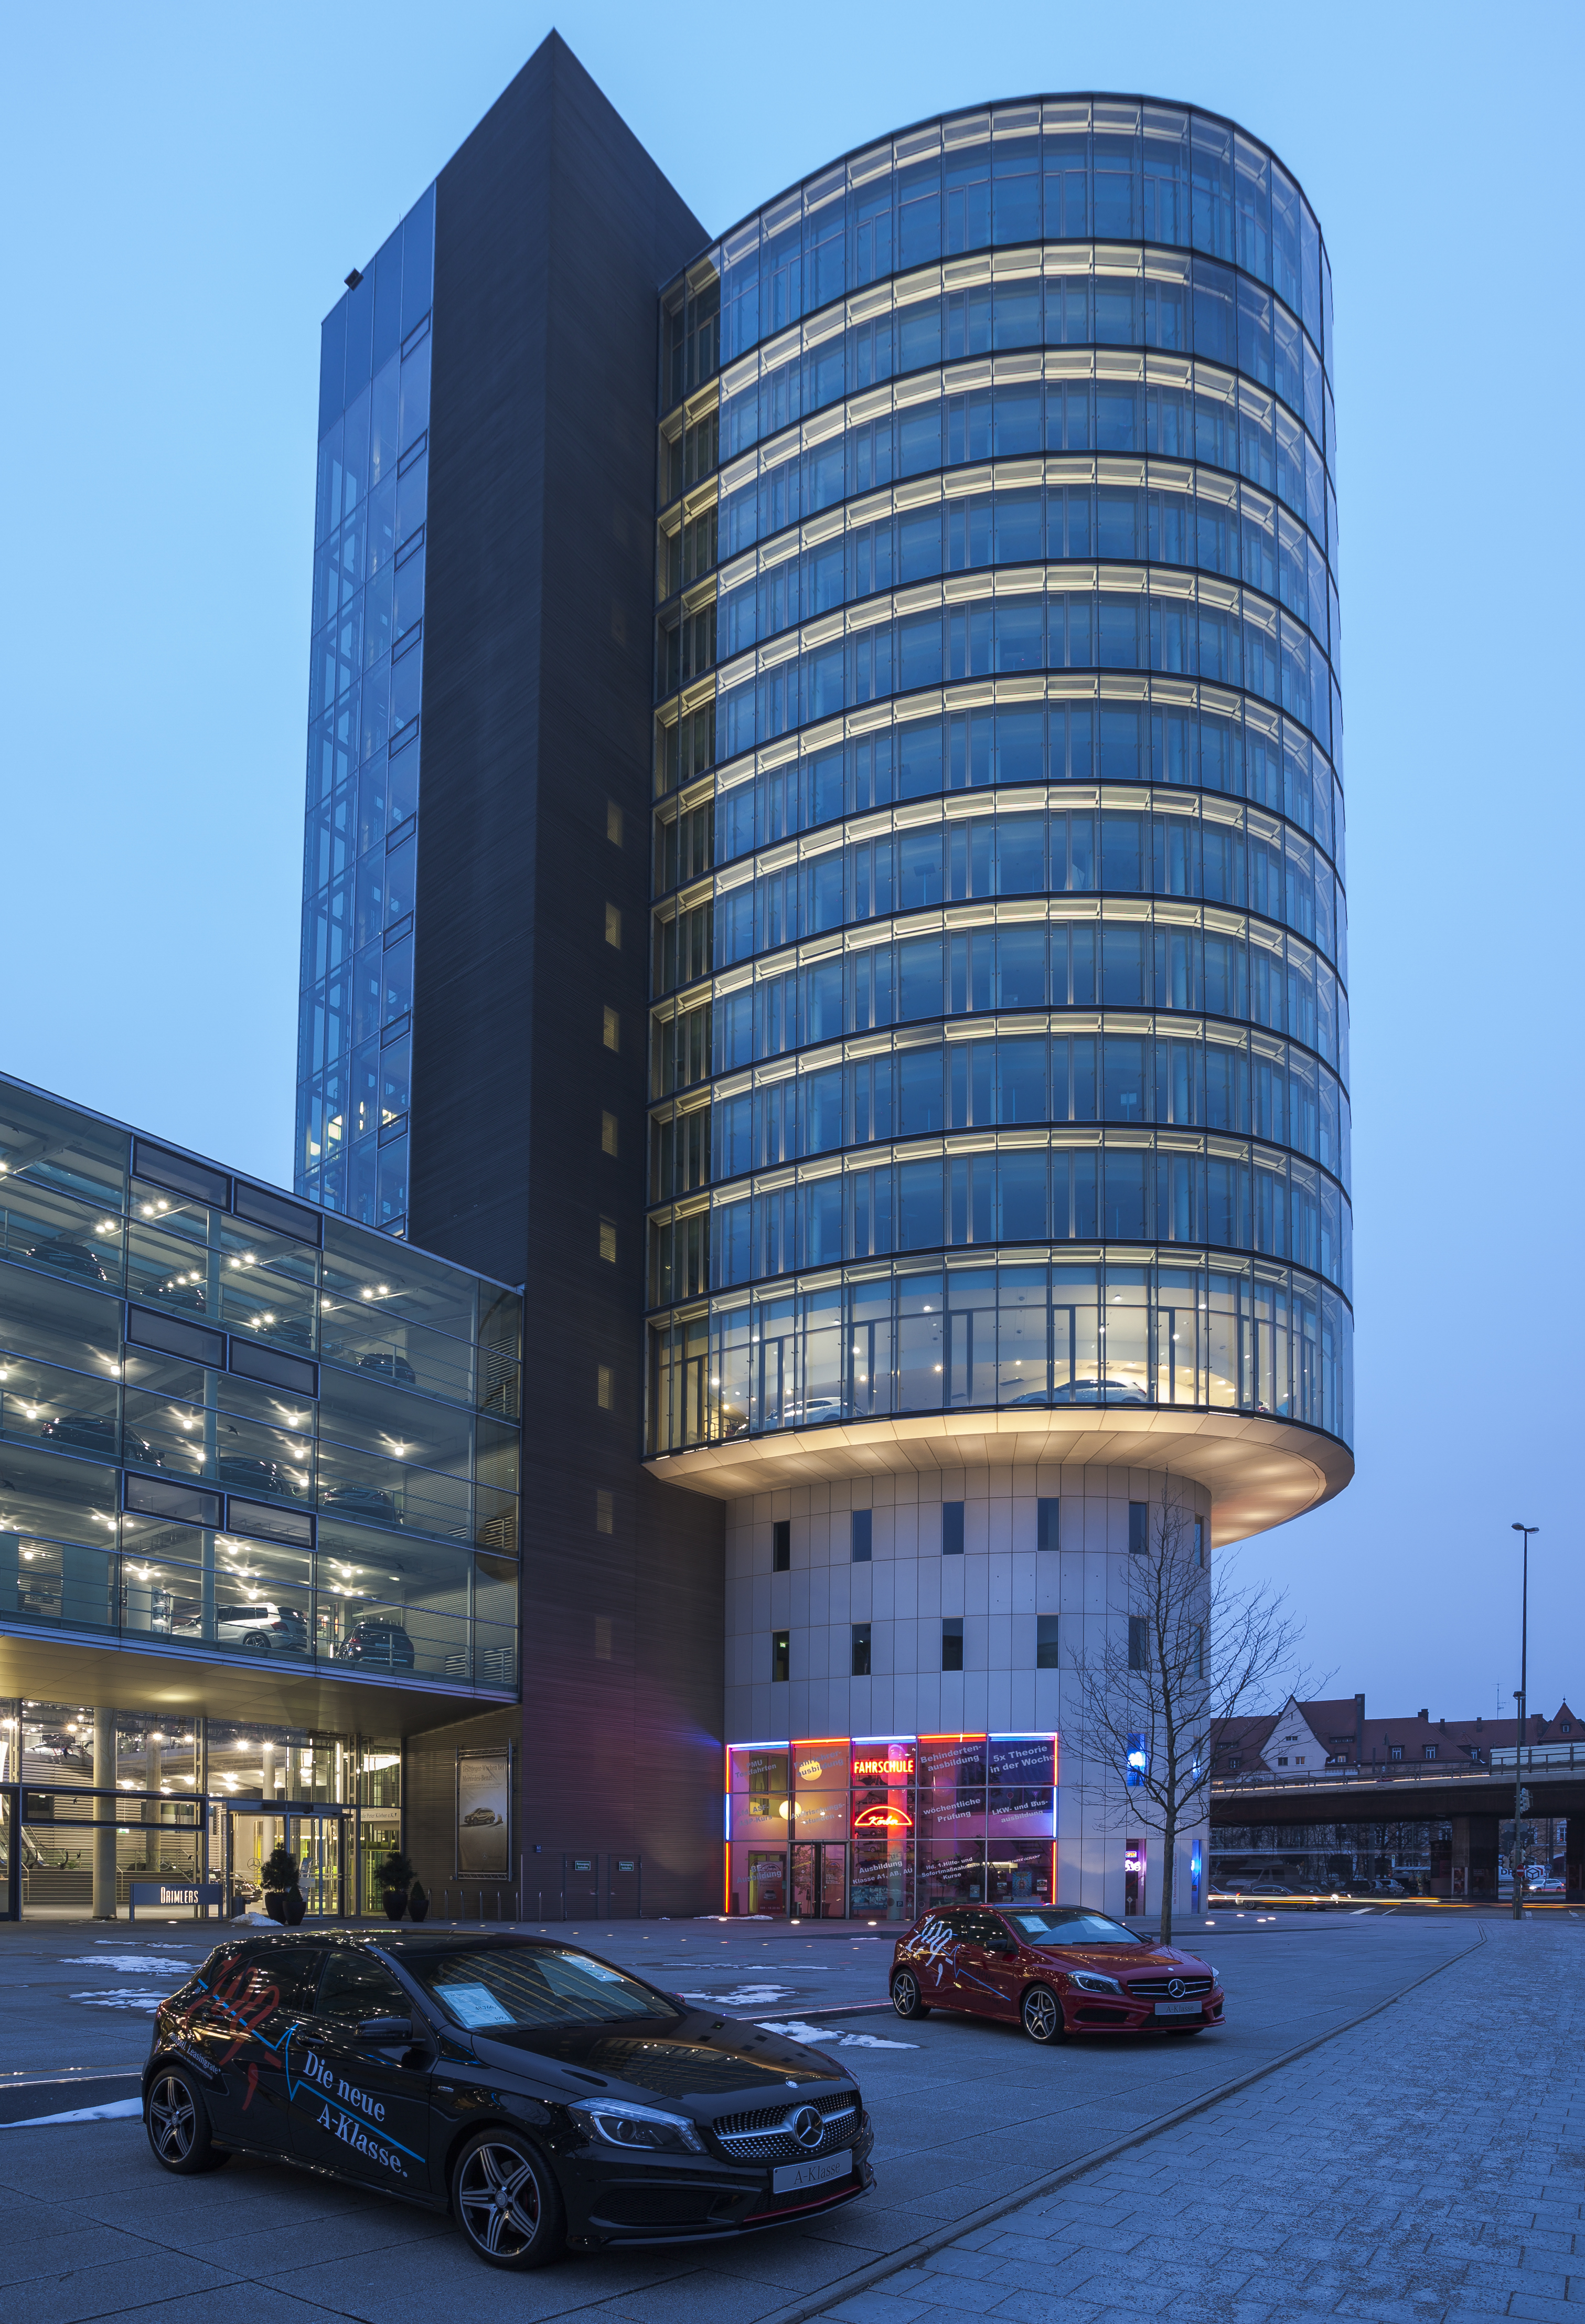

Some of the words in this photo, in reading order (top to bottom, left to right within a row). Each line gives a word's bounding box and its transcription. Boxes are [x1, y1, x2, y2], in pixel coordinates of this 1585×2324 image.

[920, 1745, 982, 1763] Behinderten-
[1008, 1745, 1047, 1758] Theorie
[746, 1760, 763, 1769] PMU
[794, 1751, 842, 1769] Fahrlehrer-
[854, 1760, 914, 1774] FAHRSCHULE
[928, 1754, 979, 1772] ausbildung
[1002, 1762, 1019, 1771] der
[1021, 1754, 1055, 1766] Woche
[735, 1763, 776, 1778] Testfahrten
[796, 1758, 844, 1777] ausbildung
[923, 1798, 981, 1815] wöchentliche
[992, 1806, 1012, 1815] LKW-
[805, 1814, 834, 1825] stunden
[869, 1815, 899, 1826] Körber
[937, 1811, 971, 1822] Prüfung
[1001, 1810, 1043, 1823] ausbildung
[859, 1861, 903, 1874] Ausbildung
[736, 1870, 781, 1883] Ausbildung
[852, 1876, 875, 1884] Klasse
[160, 1886, 198, 1904] DAIMLERS
[303, 2051, 333, 2088] Die
[337, 2079, 385, 2122] neue
[317, 2104, 408, 2177] A-Klasse.
[793, 2162, 840, 2185] A-Klasse
